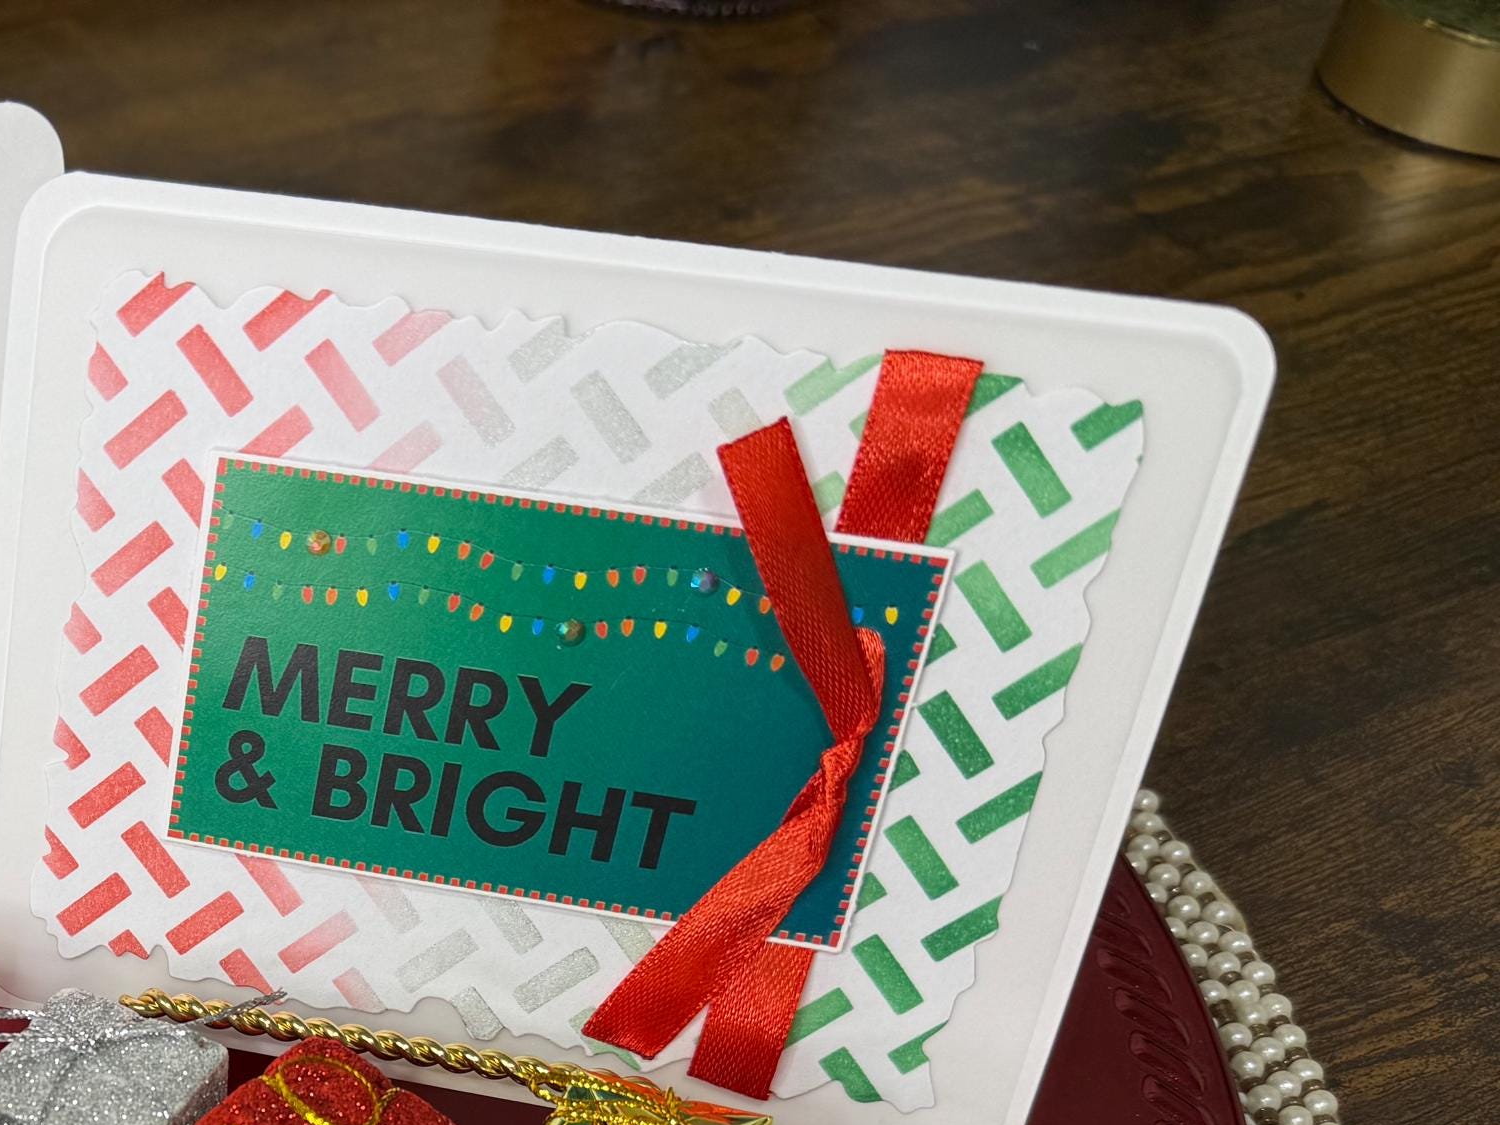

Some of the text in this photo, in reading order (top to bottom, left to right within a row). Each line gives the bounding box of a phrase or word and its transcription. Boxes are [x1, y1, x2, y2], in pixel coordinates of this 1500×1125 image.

[221, 635, 592, 758] MERRY
[214, 729, 697, 870] & BRIGHT
